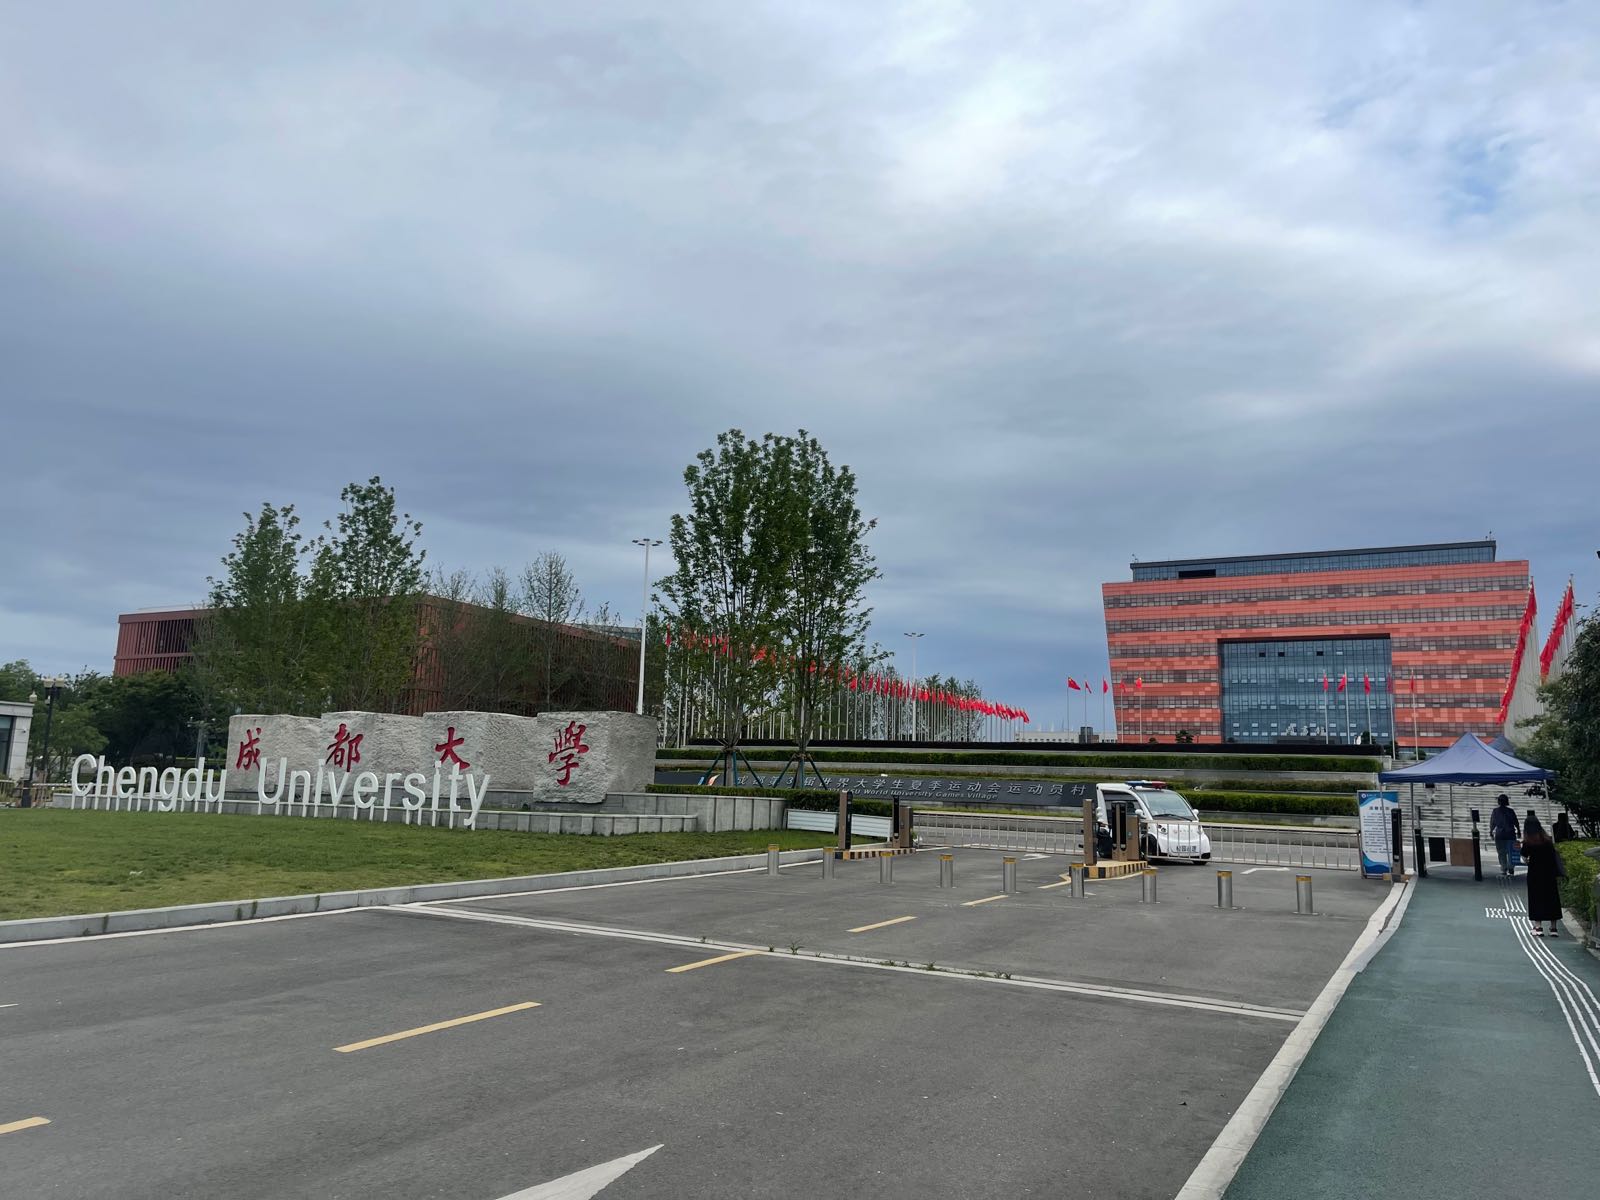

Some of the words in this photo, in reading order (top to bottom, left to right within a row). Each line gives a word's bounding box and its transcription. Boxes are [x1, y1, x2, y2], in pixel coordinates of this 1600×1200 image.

[233, 719, 590, 786] 成都大學
[71, 753, 227, 812] Chengdu
[258, 757, 491, 827] University
[736, 775, 1087, 797] 成都第3届世界大学生夏季运动会运动员村
[890, 789, 933, 798] University
[967, 792, 999, 800] Village
